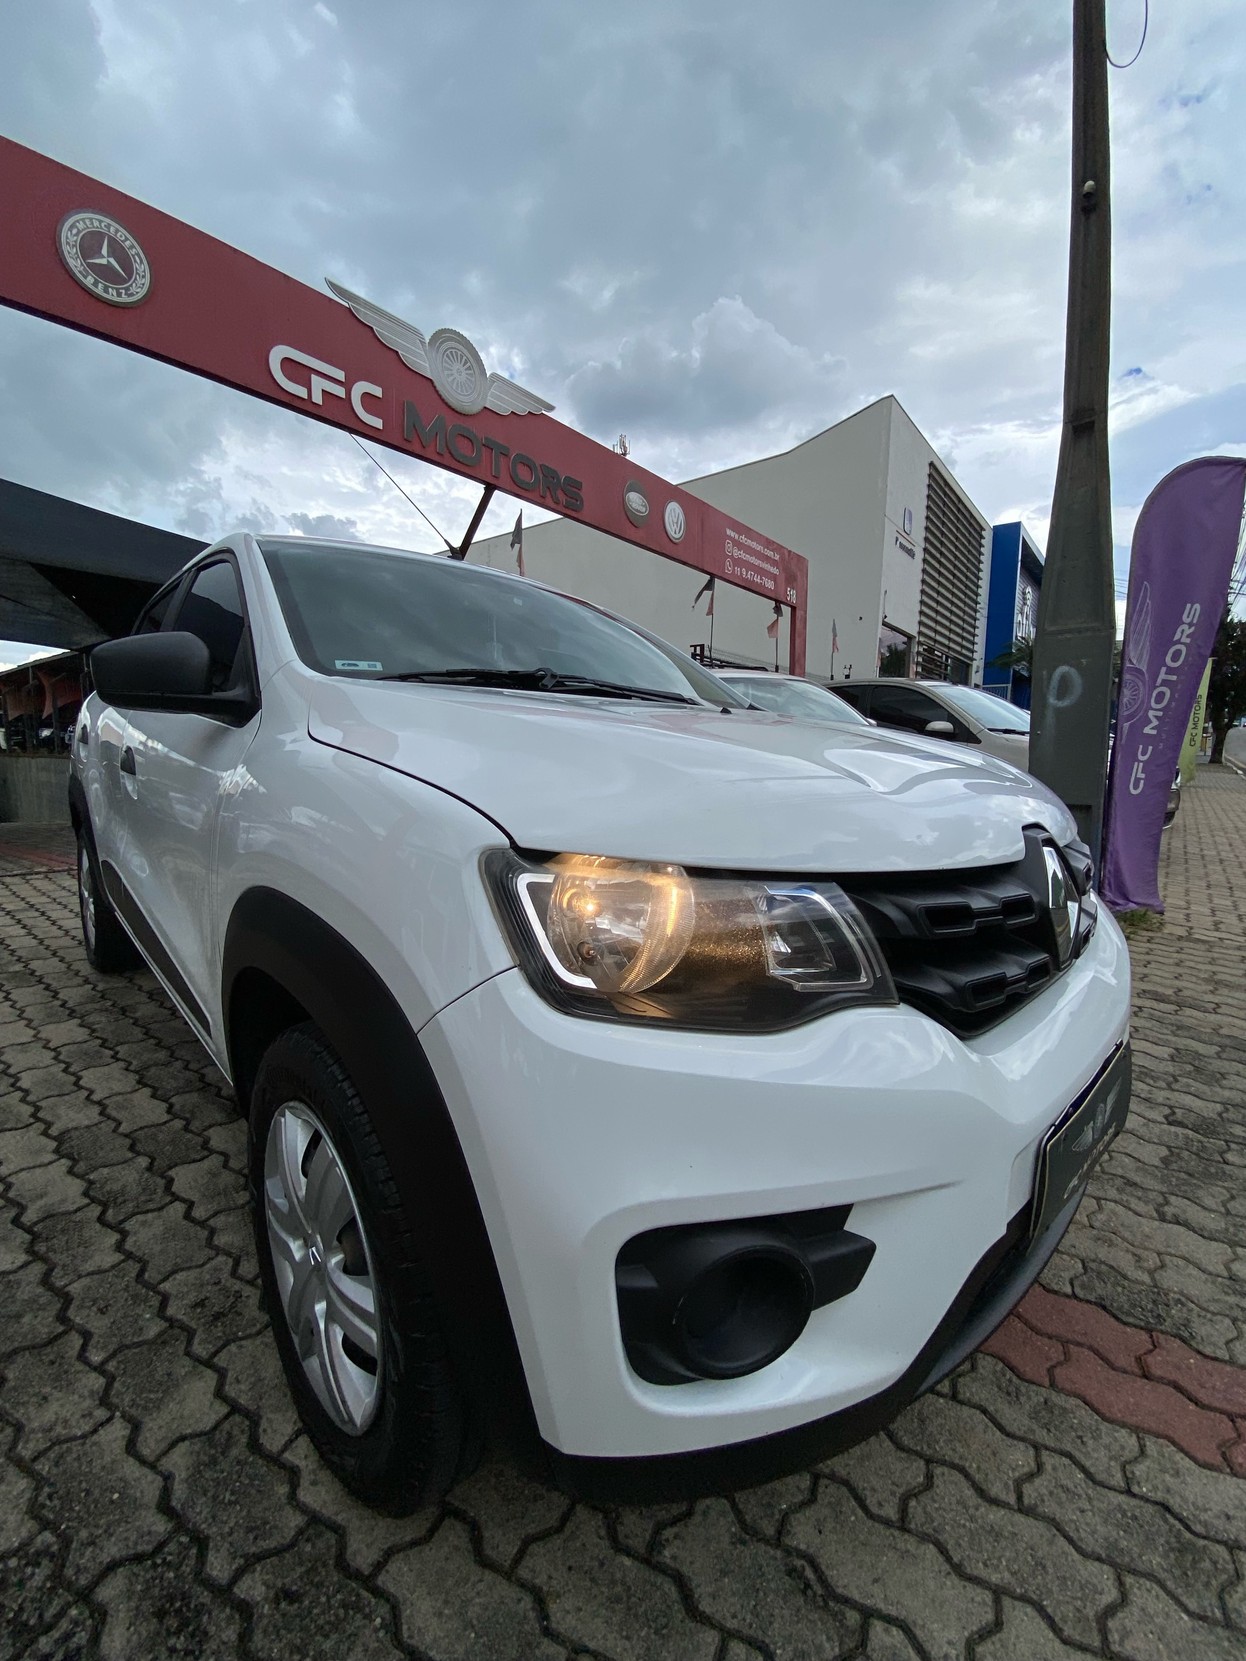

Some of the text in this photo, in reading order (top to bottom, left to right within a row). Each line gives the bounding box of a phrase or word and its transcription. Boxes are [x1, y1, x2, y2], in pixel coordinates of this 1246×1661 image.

[76, 218, 137, 255] MERCEDES
[86, 275, 128, 298] BENZ
[268, 344, 584, 512] CFC MOTORS
[726, 527, 780, 560] www.cfcmotors.com.br
[786, 587, 797, 604] 518
[1129, 602, 1201, 795] CFC MOTORS
[1189, 732, 1198, 747] CFC
